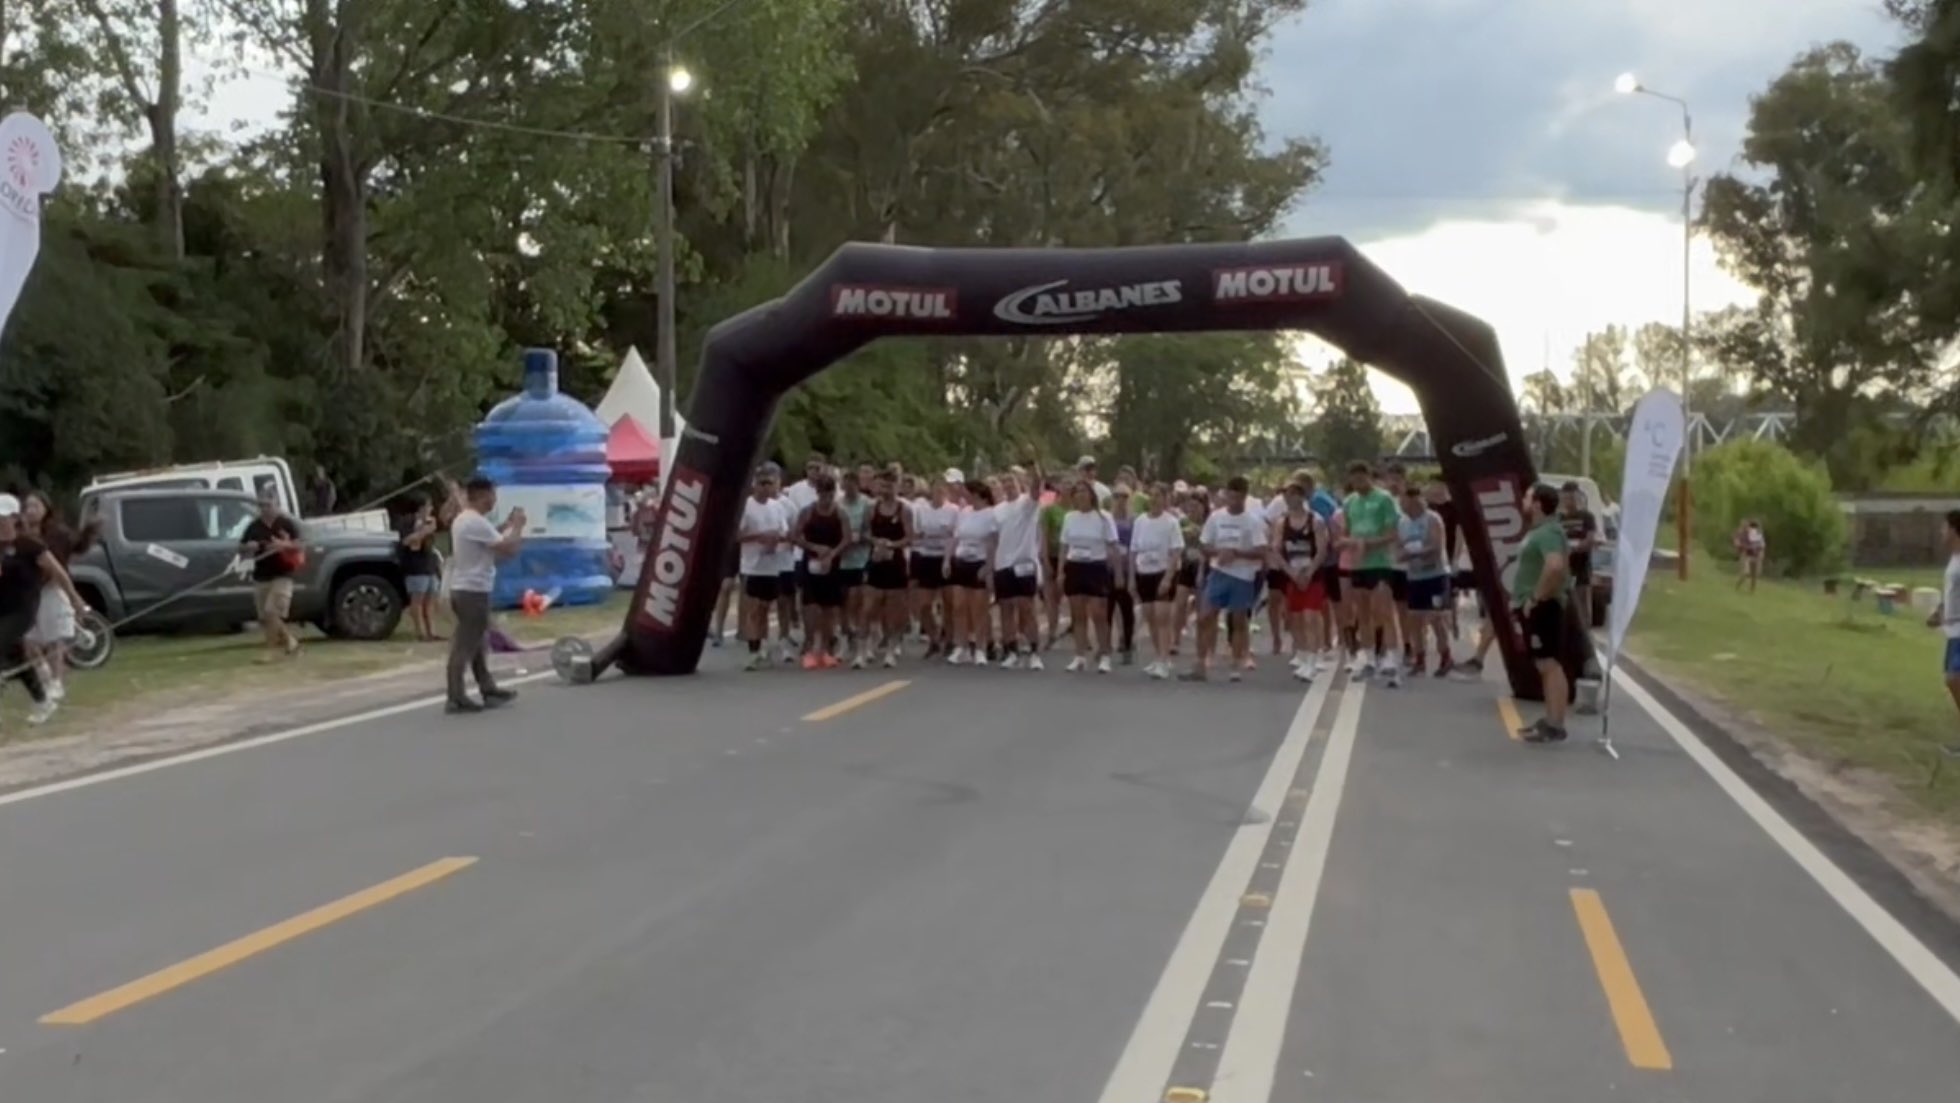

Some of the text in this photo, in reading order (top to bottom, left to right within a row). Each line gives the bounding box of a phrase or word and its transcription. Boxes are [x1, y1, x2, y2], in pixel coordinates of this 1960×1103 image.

[1033, 279, 1182, 316] ALBANES
[1216, 265, 1335, 299] MOTUL
[836, 288, 951, 318] MOTUL
[644, 479, 703, 627] MOTUL
